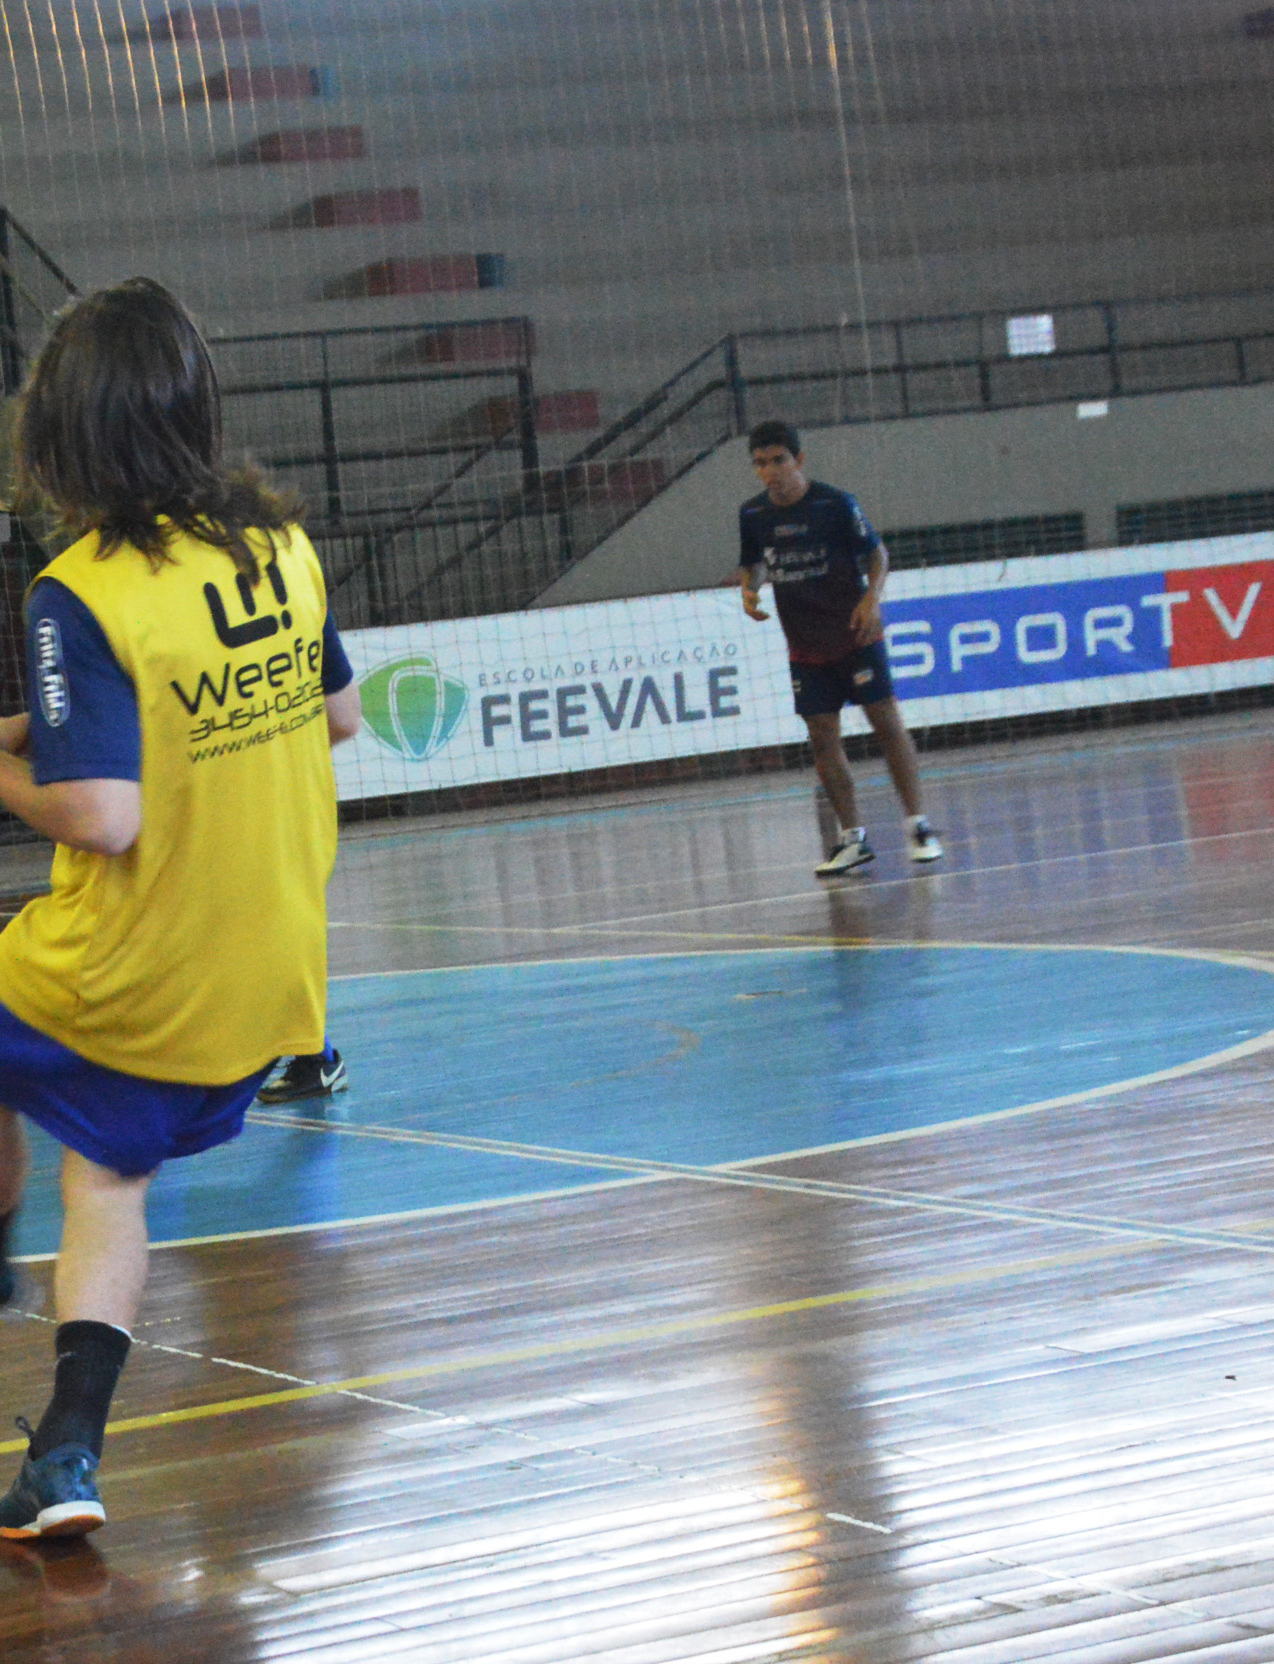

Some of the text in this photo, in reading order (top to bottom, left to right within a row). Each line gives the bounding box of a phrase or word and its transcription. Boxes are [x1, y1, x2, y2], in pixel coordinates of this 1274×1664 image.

[478, 642, 739, 688] ESCOLA DE APLICAÇÃO
[883, 581, 1263, 680] SPORTV
[170, 637, 322, 717] Weefe
[480, 665, 742, 748] FEEVALE
